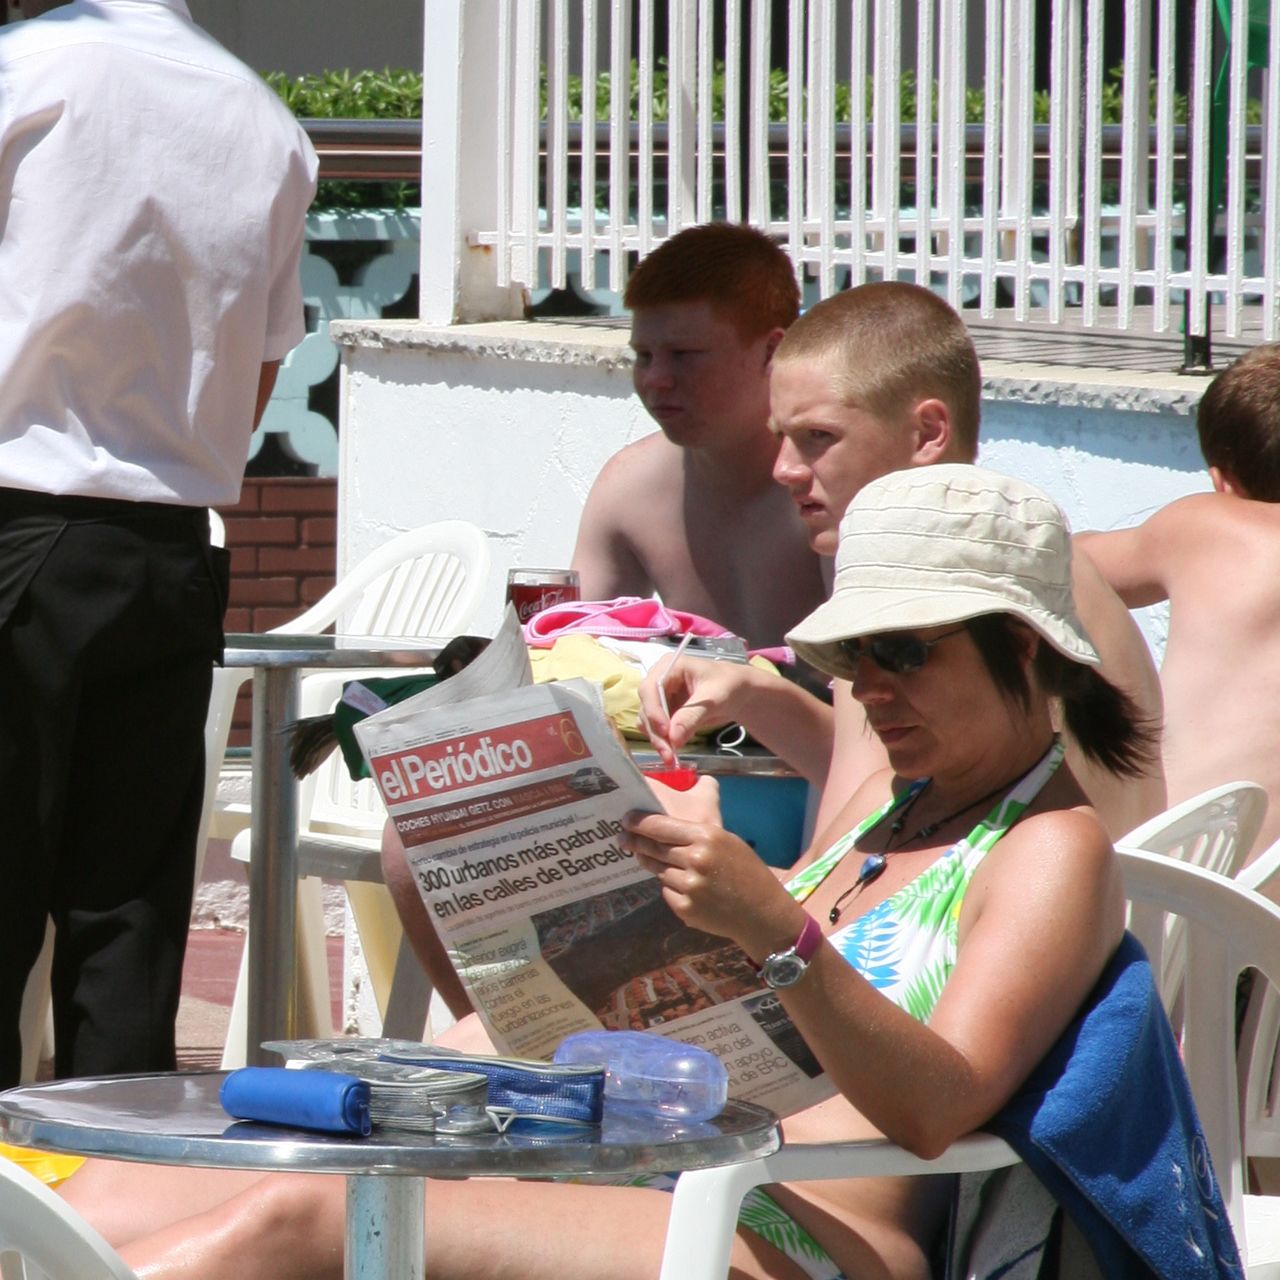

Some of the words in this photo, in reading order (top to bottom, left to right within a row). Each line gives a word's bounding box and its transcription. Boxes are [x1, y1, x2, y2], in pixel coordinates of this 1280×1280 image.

[380, 760, 408, 799] el
[401, 736, 532, 795] Periódico
[397, 814, 431, 832] COCHES
[431, 807, 468, 824] HYUNDAI
[468, 800, 492, 817] GETZ
[493, 796, 513, 810] CON
[458, 845, 468, 855] de
[467, 835, 500, 852] estrategia
[500, 834, 510, 843] en
[539, 814, 575, 834] municipal
[419, 866, 450, 893] 300
[451, 853, 519, 885] urbanos
[519, 840, 559, 867] más
[559, 818, 626, 858] patrulla
[434, 900, 456, 918] en
[456, 890, 484, 912] las
[483, 872, 537, 903] calles
[536, 863, 562, 886] de
[557, 844, 634, 877] Barcelo
[706, 1022, 742, 1042] activa
[732, 1033, 754, 1050] del
[734, 1046, 774, 1070] apoyo
[740, 1067, 759, 1082] de
[756, 1055, 789, 1076] ERC
